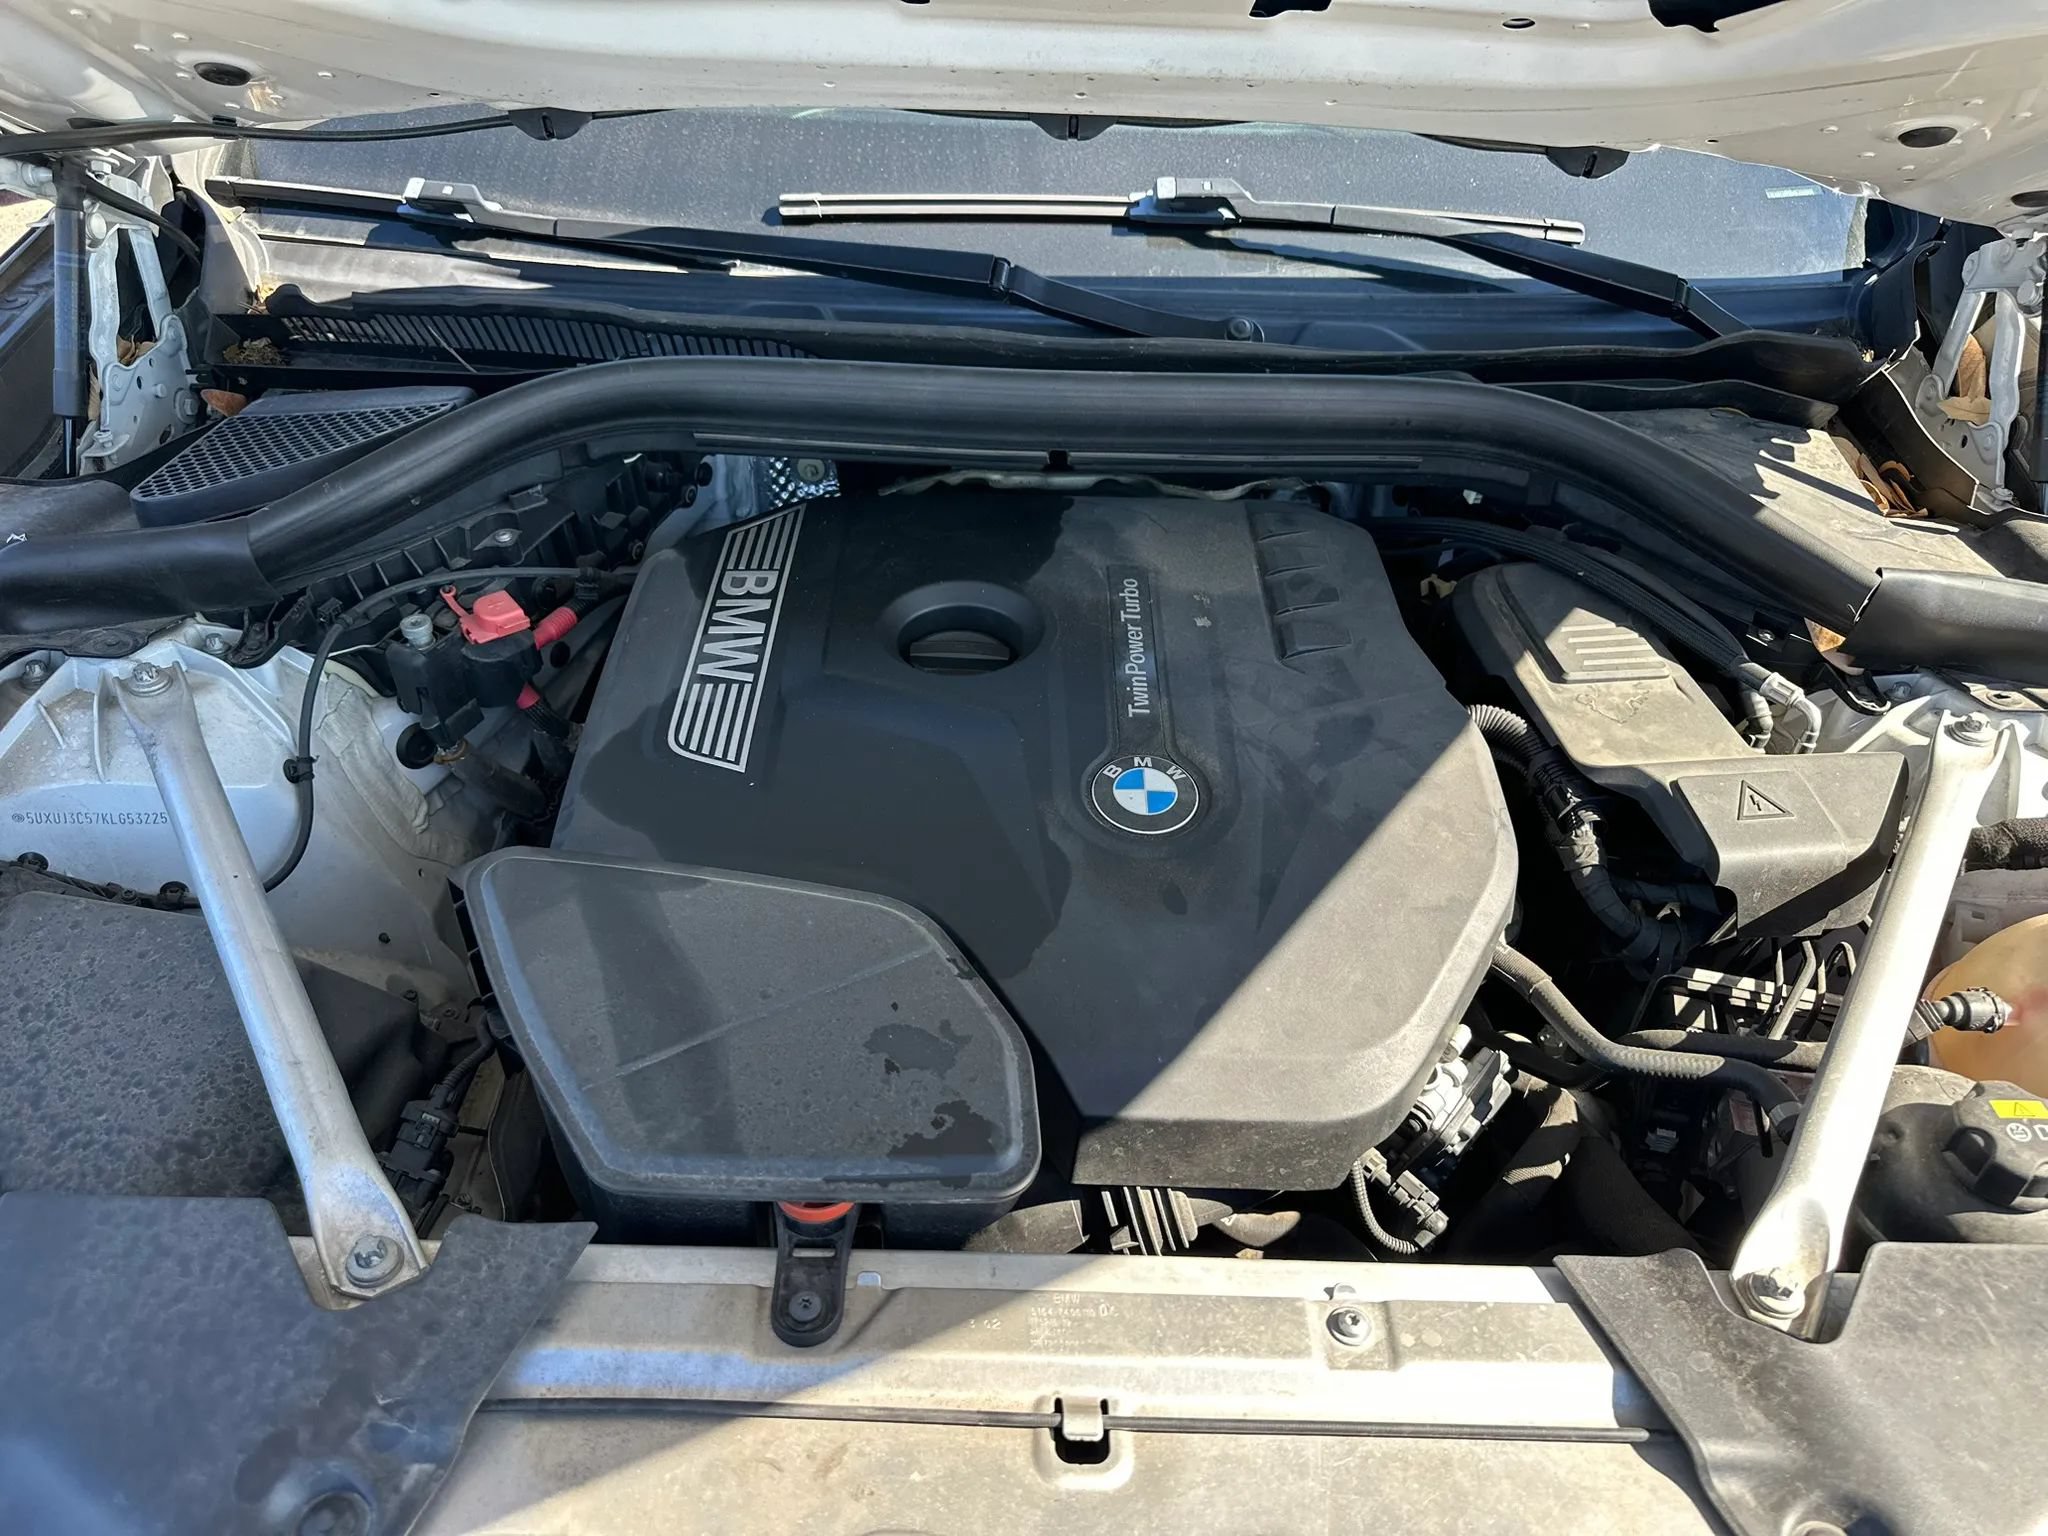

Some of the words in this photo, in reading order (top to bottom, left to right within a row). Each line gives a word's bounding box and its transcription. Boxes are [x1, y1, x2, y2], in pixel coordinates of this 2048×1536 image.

[1119, 578, 1142, 622] Turbo
[696, 570, 780, 682] BMW
[1124, 623, 1151, 718] TwinPower
[1103, 756, 1187, 780] BMW
[26, 811, 168, 825] 5UXUJ3C57KLG53225
